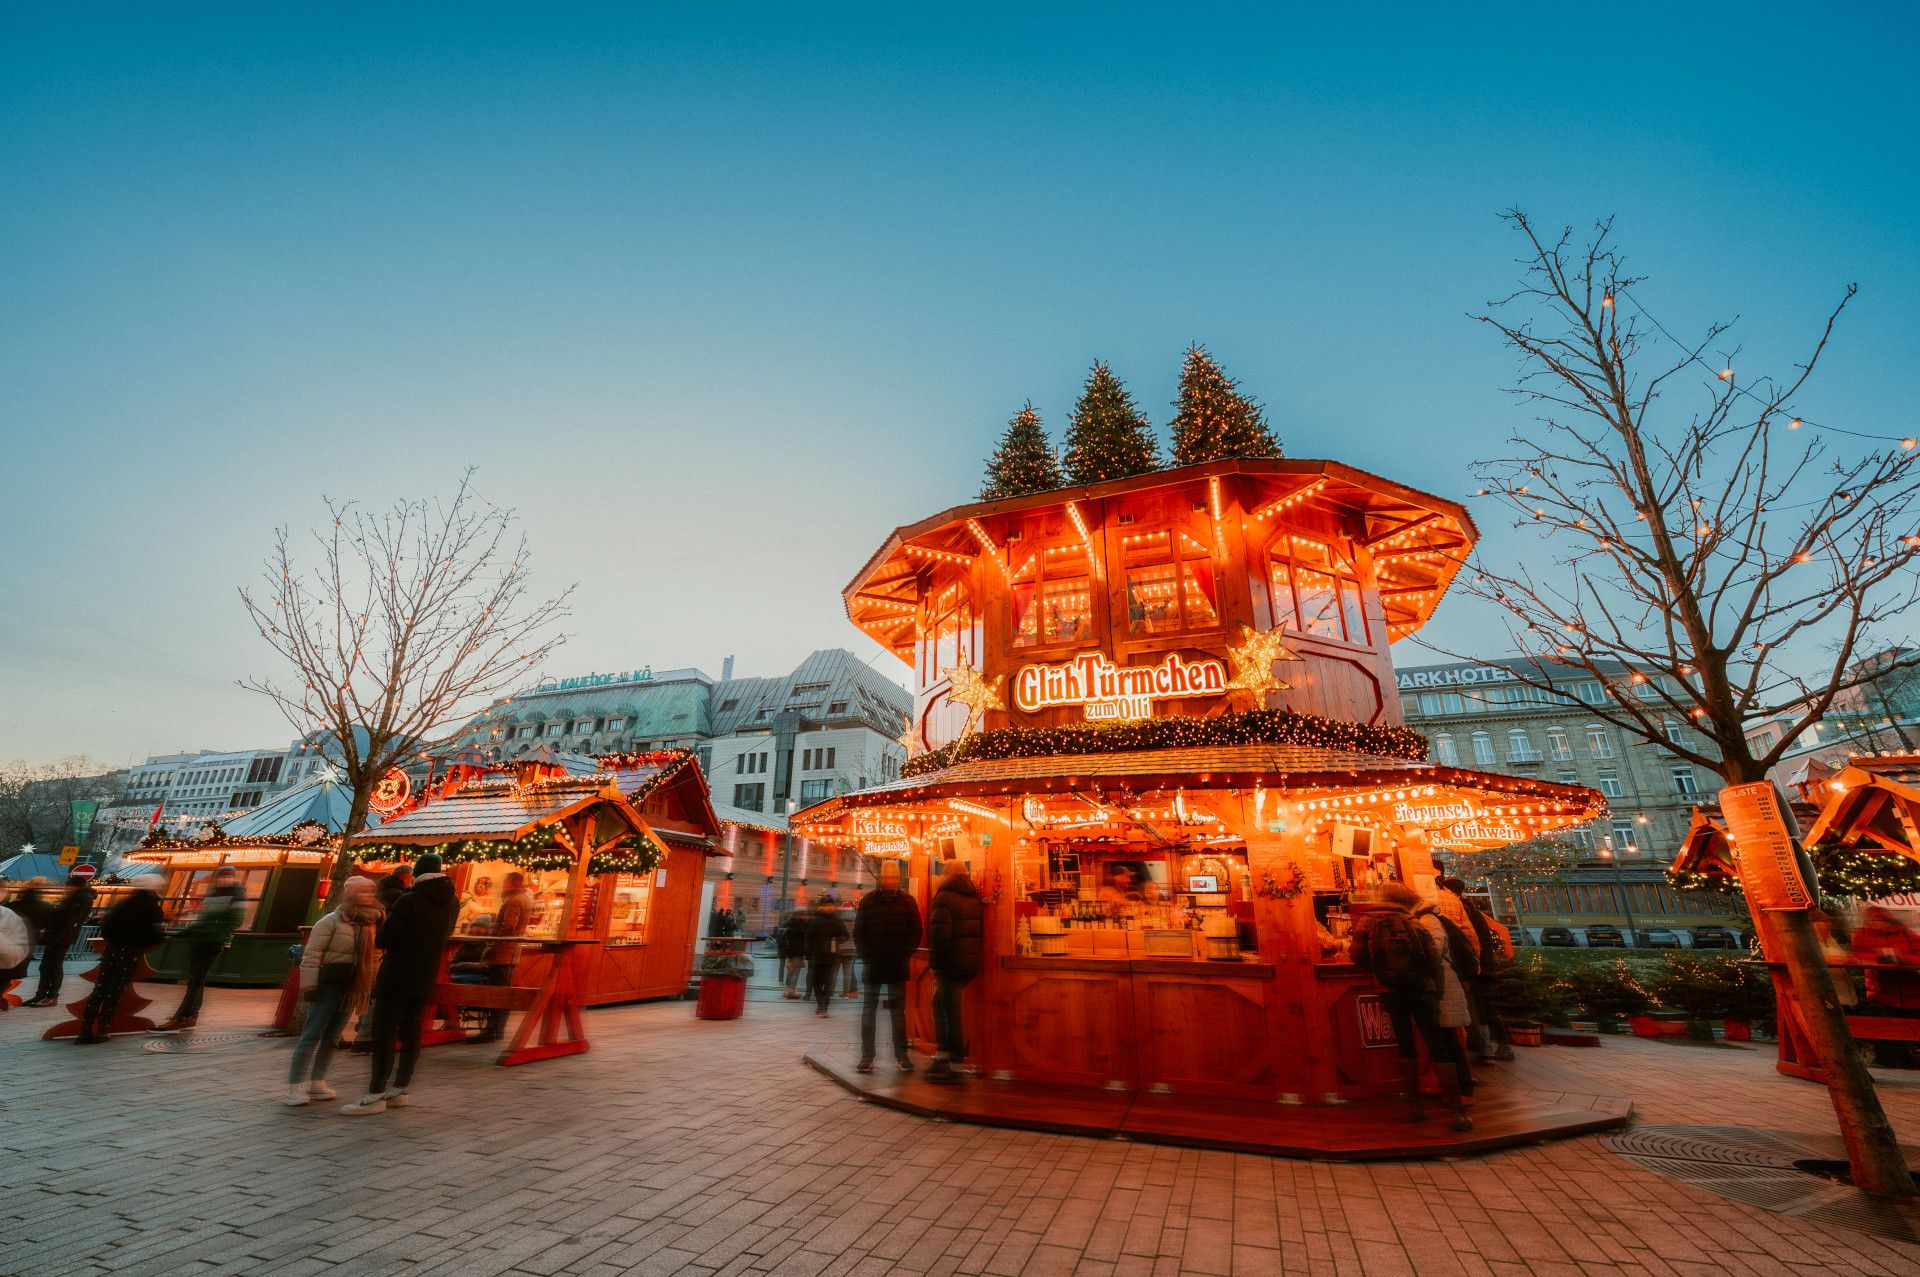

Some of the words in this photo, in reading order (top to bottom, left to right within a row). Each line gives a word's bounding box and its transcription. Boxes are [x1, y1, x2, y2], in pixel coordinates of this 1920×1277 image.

[1018, 654, 1224, 709] GlühTürmchen
[1086, 702, 1115, 718] zum
[1118, 697, 1151, 719] Olli
[1393, 799, 1473, 823] Eierpunsch
[854, 819, 907, 836] Kakao
[1450, 823, 1523, 841] Glühwein
[1361, 1002, 1395, 1040] We
